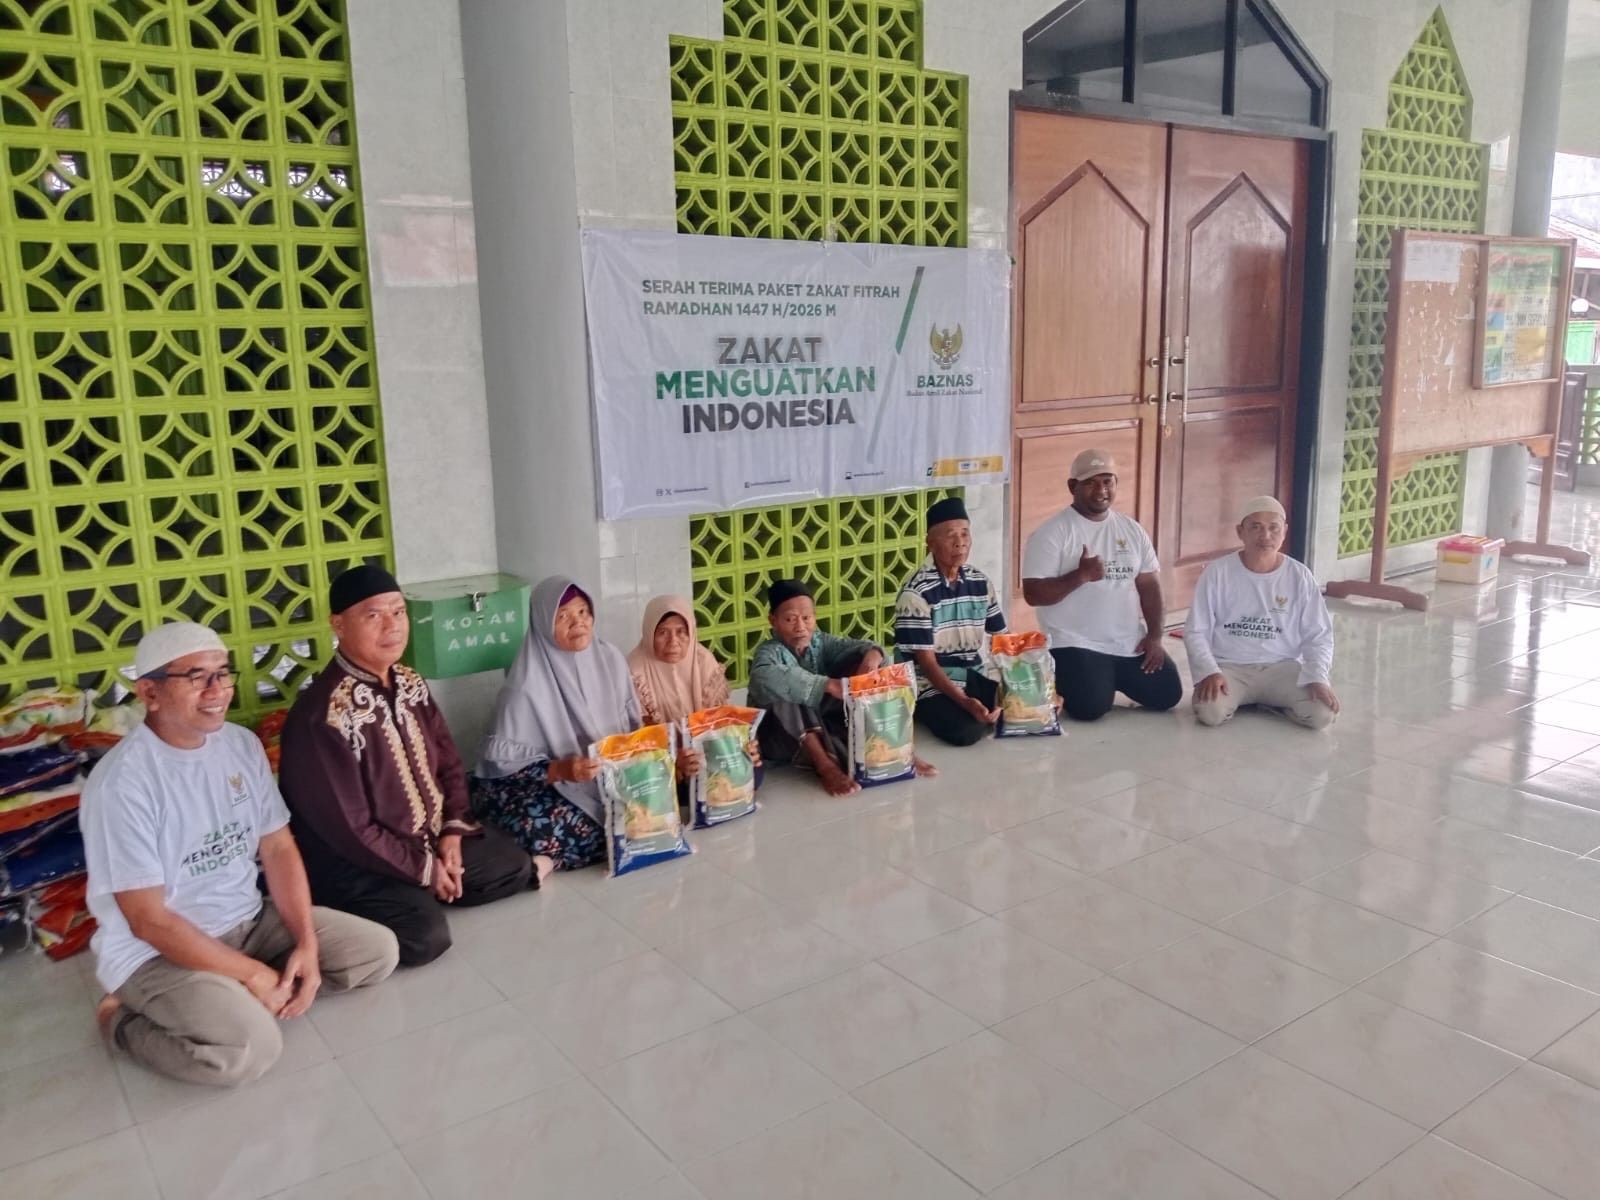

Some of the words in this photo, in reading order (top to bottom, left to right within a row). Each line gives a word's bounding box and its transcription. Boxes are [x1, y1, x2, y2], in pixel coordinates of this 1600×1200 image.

[642, 280, 695, 295] SERAH
[699, 281, 754, 296] TERIMA
[758, 283, 802, 297] PAKET
[806, 284, 850, 298] ZAKAT
[853, 286, 900, 299] FITRAH
[643, 301, 733, 316] RAMADHAN
[736, 303, 769, 316] 1447
[825, 303, 837, 316] M
[717, 336, 823, 365] ZAKAT
[655, 366, 876, 400] MENGUATKAN
[916, 374, 974, 388] BAZNAS
[682, 398, 857, 434] INDONESIA
[448, 631, 510, 652] AMAL
